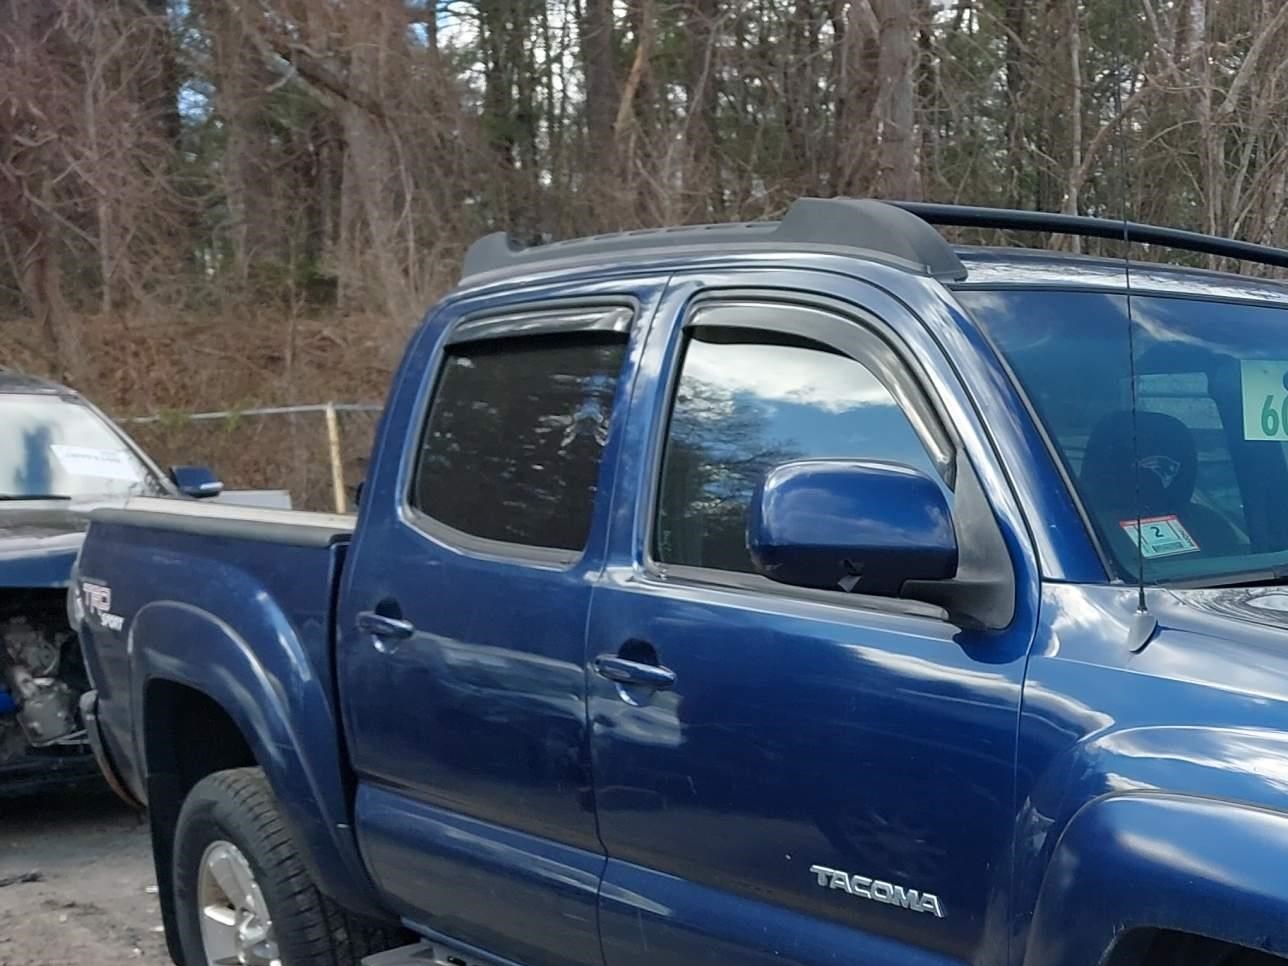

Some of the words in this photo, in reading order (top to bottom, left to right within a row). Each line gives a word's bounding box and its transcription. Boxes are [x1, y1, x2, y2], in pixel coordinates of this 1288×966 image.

[1150, 526, 1164, 538] 2
[82, 582, 111, 614] TRD
[809, 864, 945, 918] TACOMA
